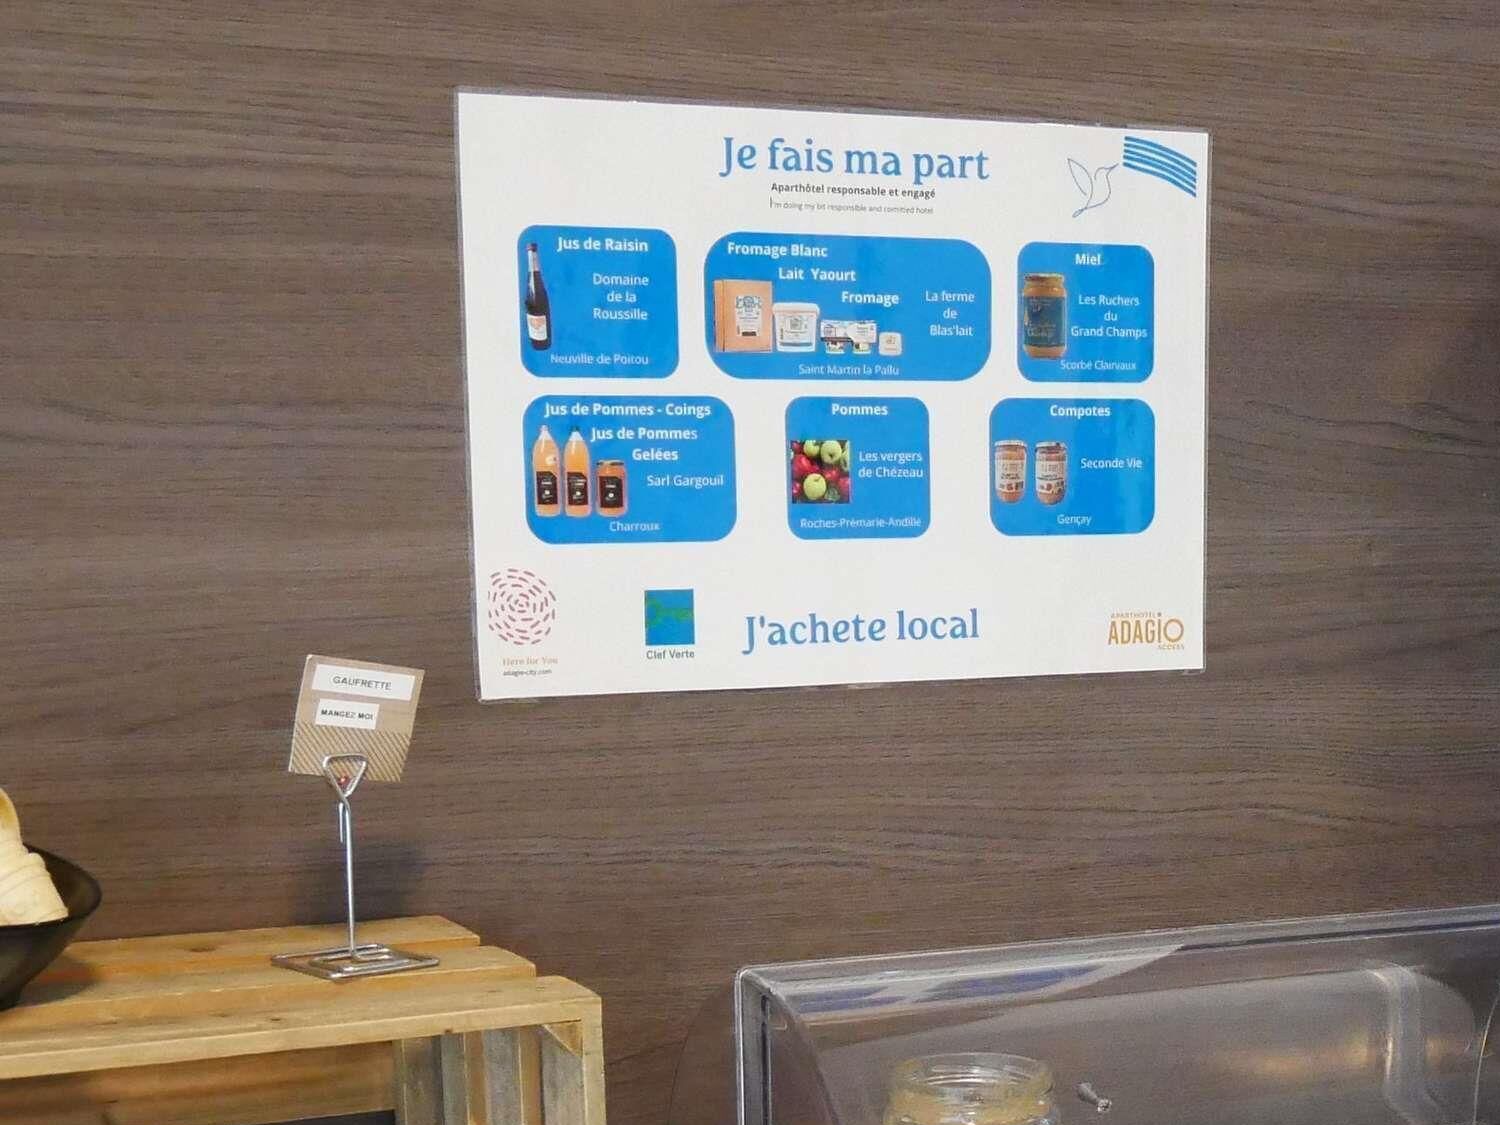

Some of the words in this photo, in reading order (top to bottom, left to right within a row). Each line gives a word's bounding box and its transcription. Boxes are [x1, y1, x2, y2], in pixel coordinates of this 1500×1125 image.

[718, 136, 757, 178] Je
[767, 137, 834, 173] fais
[844, 149, 901, 176] ma
[913, 149, 990, 186] part
[771, 182, 825, 193] Aparthôtel
[827, 184, 887, 197] responsable
[889, 187, 900, 197] et
[902, 189, 936, 200] engagé
[556, 237, 580, 252] Jus
[584, 237, 601, 250] de
[605, 238, 649, 251] Raisin
[727, 241, 787, 259] Fromage
[791, 243, 828, 257] Blanc
[1075, 253, 1102, 266] Miel
[592, 273, 650, 286] Domaine
[779, 267, 804, 280] Lait
[811, 268, 857, 282] Yaourt
[606, 291, 623, 302] de
[625, 291, 637, 303] la
[841, 290, 900, 307] Fromage
[925, 290, 938, 302] La
[941, 291, 976, 302] ferme
[1078, 294, 1097, 306] Les
[1099, 294, 1141, 306] Ruchers
[593, 308, 648, 320] Roussille
[943, 308, 958, 320] de
[1104, 311, 1119, 322] du
[929, 324, 973, 337] Blas'lait
[1071, 326, 1104, 338] Grand
[1106, 326, 1148, 340] Champs
[550, 353, 594, 364] Neuville
[596, 354, 611, 364] de
[613, 354, 649, 365] Poitou
[1060, 359, 1093, 370] Scorbé
[1094, 360, 1137, 371] Clairvaux
[799, 363, 824, 375] Saint
[826, 364, 862, 376] Martin
[863, 364, 873, 375] la
[543, 403, 567, 418] Jus
[571, 403, 589, 416] de
[592, 404, 654, 417] Pommes
[665, 403, 712, 419] Coings
[831, 403, 889, 416] Pommes
[1049, 404, 1112, 419] Compotes
[590, 427, 613, 442] Jus
[617, 427, 635, 440] de
[638, 428, 698, 441] Pommes
[631, 447, 679, 461] Gelées
[858, 451, 878, 463] Les
[880, 453, 923, 465] vergers
[1080, 458, 1125, 470] Seconde
[1126, 459, 1144, 470] Vie
[858, 467, 873, 478] de
[876, 466, 924, 479] Chézeau
[646, 475, 670, 487] Sarl
[673, 475, 725, 490] Gargouil
[609, 521, 661, 532] Charroux
[1056, 514, 1093, 528] Gençay
[742, 613, 887, 655] J'achete
[896, 607, 980, 641] local
[1107, 617, 1185, 646] ADAGIO
[645, 649, 666, 661] Clef
[668, 649, 696, 660] Verte
[332, 675, 393, 691] GAUFRETTE
[357, 712, 374, 721] MOI
